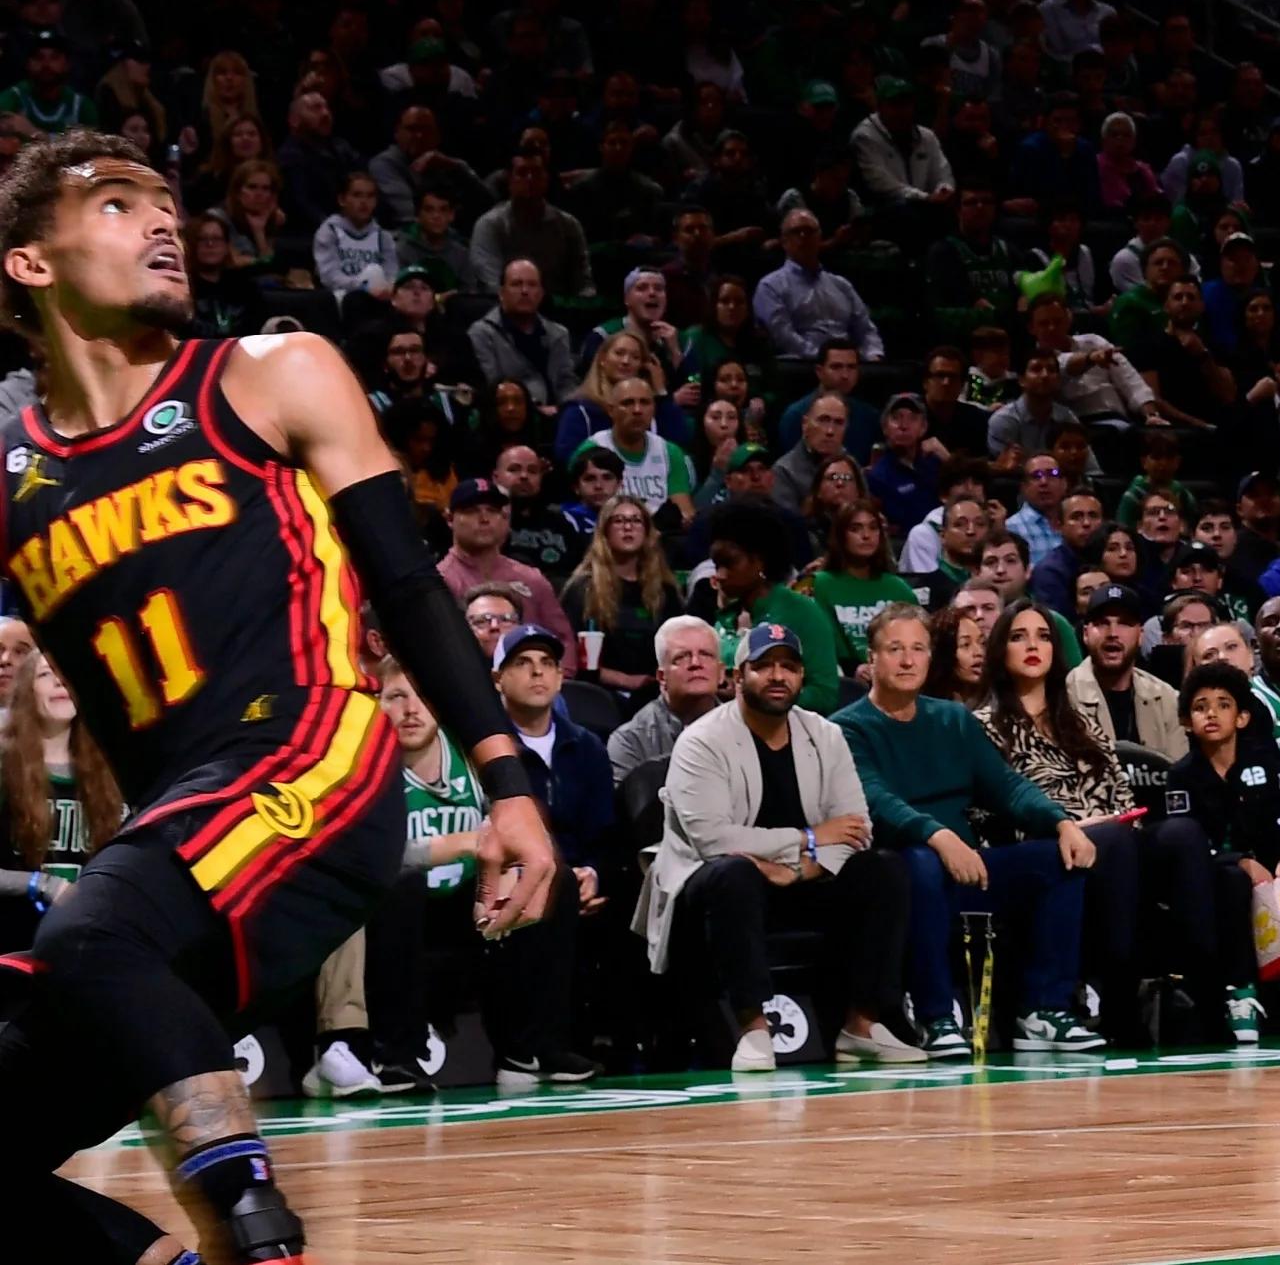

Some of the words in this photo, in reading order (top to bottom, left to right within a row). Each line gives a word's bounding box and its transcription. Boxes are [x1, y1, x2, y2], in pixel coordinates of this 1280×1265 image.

[8, 457, 240, 623] HAWKS
[91, 586, 208, 733] 11
[1240, 765, 1268, 787] 42
